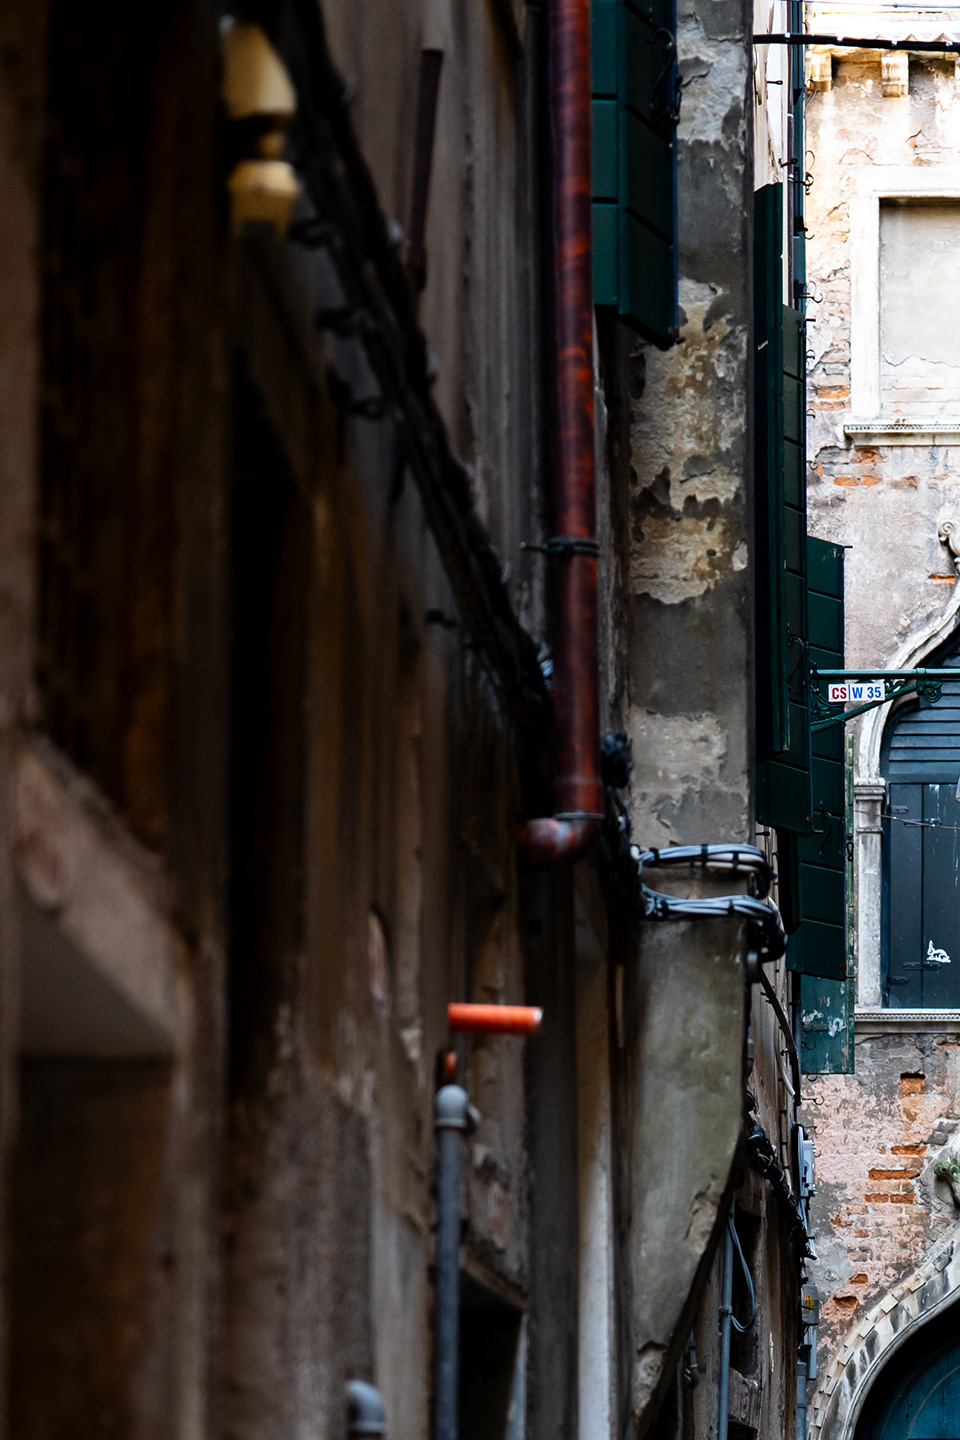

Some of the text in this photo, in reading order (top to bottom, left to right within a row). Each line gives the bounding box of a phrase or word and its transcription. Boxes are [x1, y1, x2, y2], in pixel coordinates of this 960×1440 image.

[832, 687, 881, 699] CS W 35
